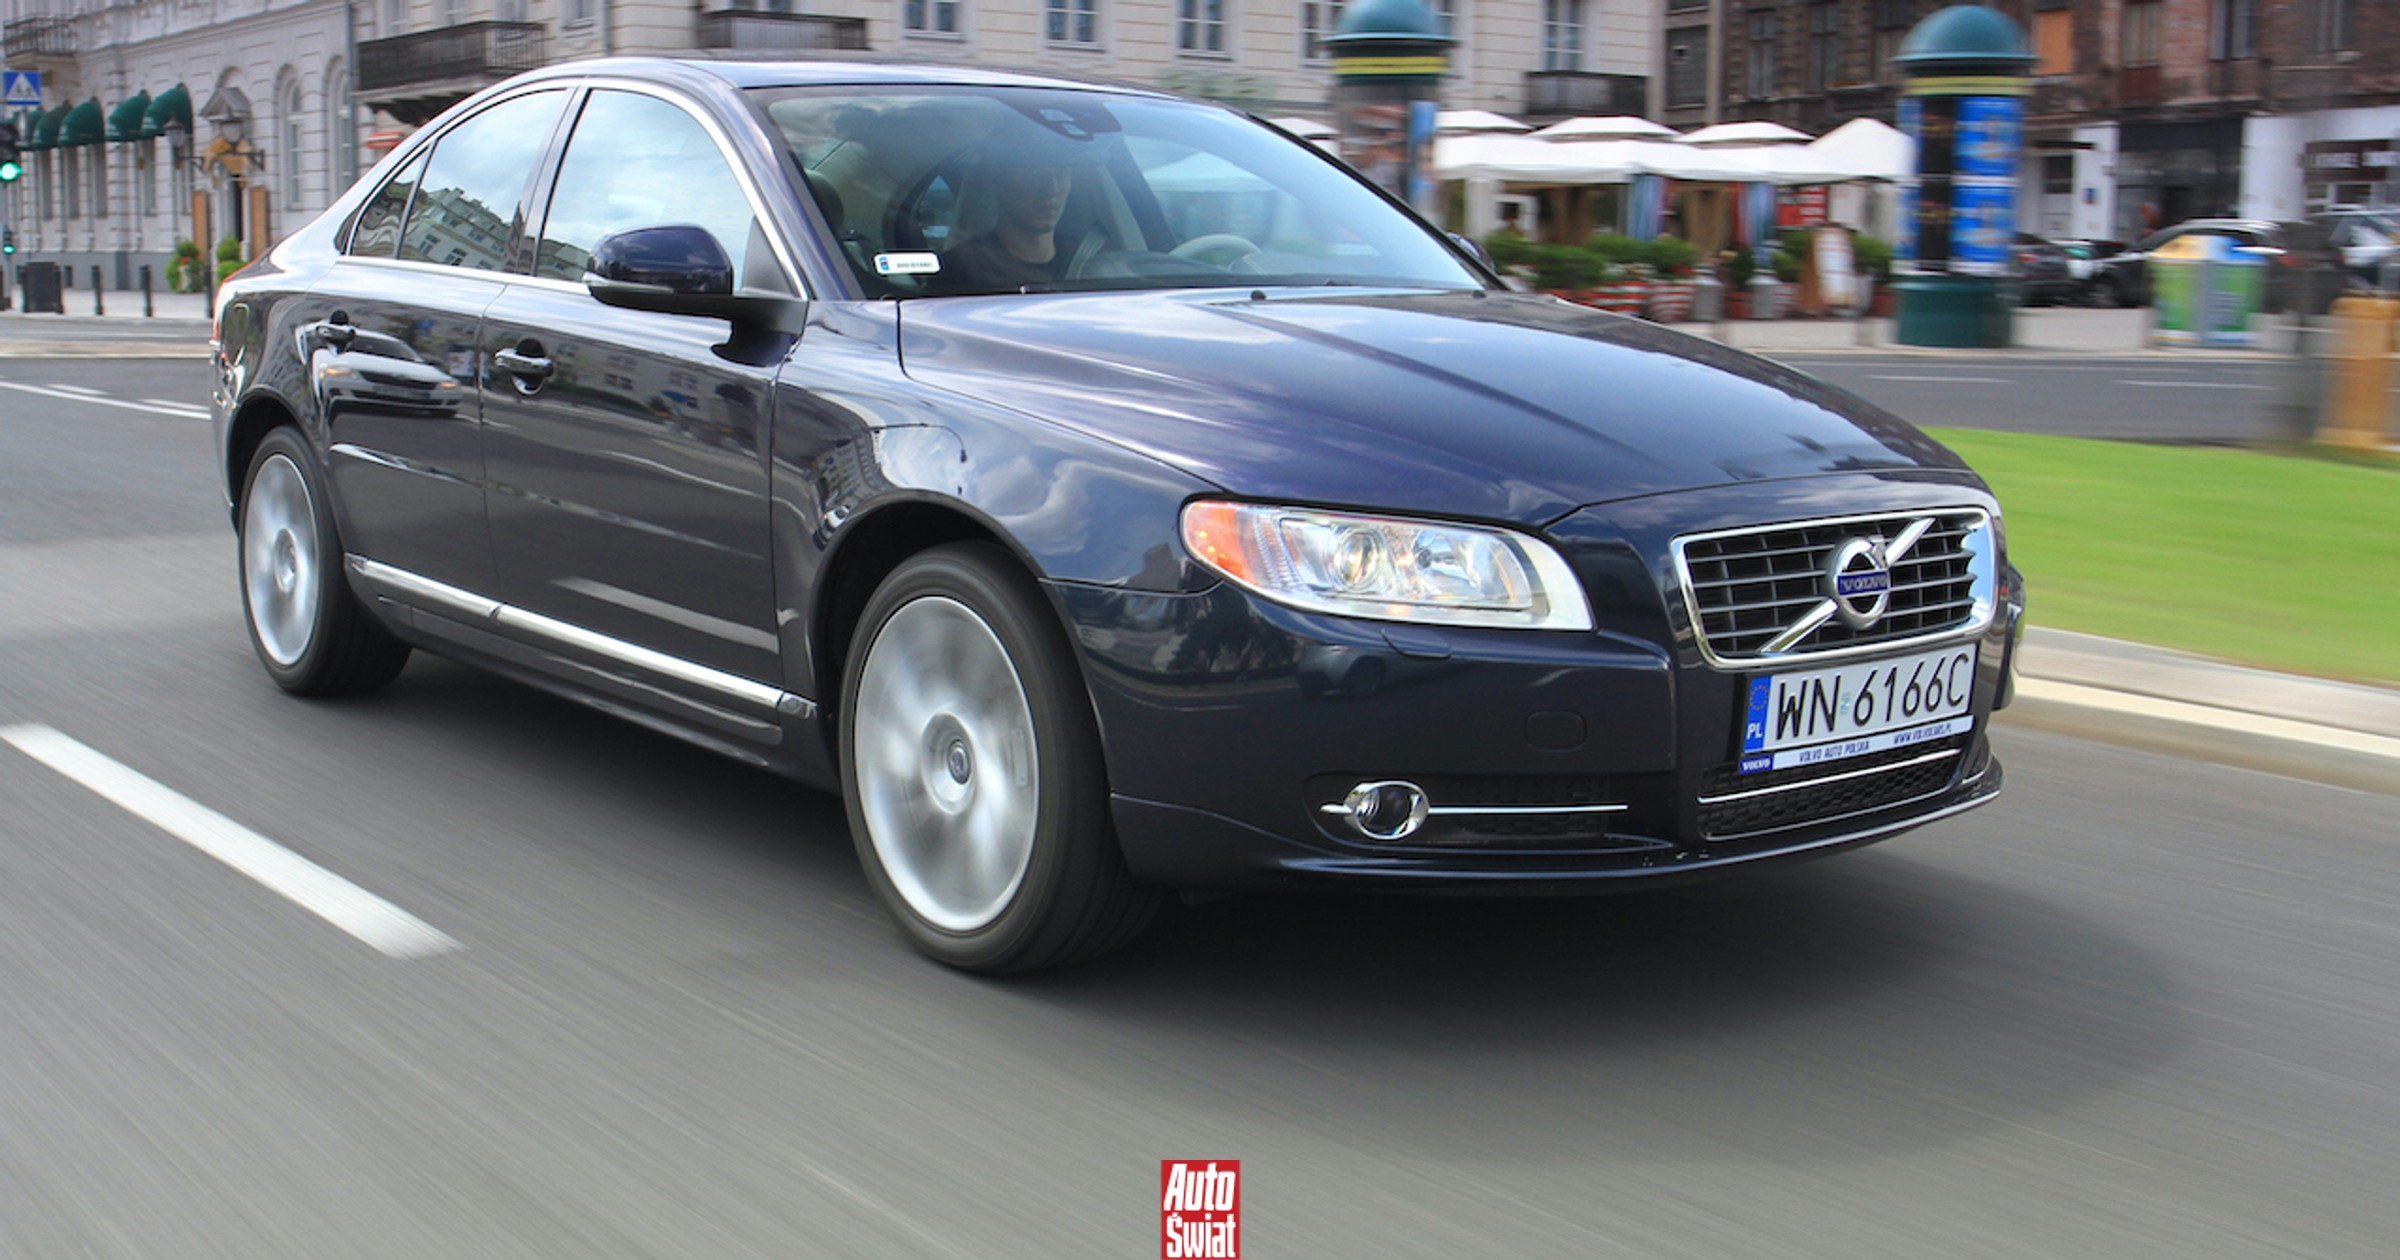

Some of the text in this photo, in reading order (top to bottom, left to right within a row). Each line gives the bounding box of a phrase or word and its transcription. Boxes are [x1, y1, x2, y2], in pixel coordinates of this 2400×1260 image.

[1841, 574, 1888, 592] VOLVO
[1775, 652, 1969, 741] WN 6166C
[1746, 723, 1763, 739] PL
[1800, 740, 1870, 763] VOLVO AUTO POLSKA
[1742, 758, 1771, 771] VOLVO
